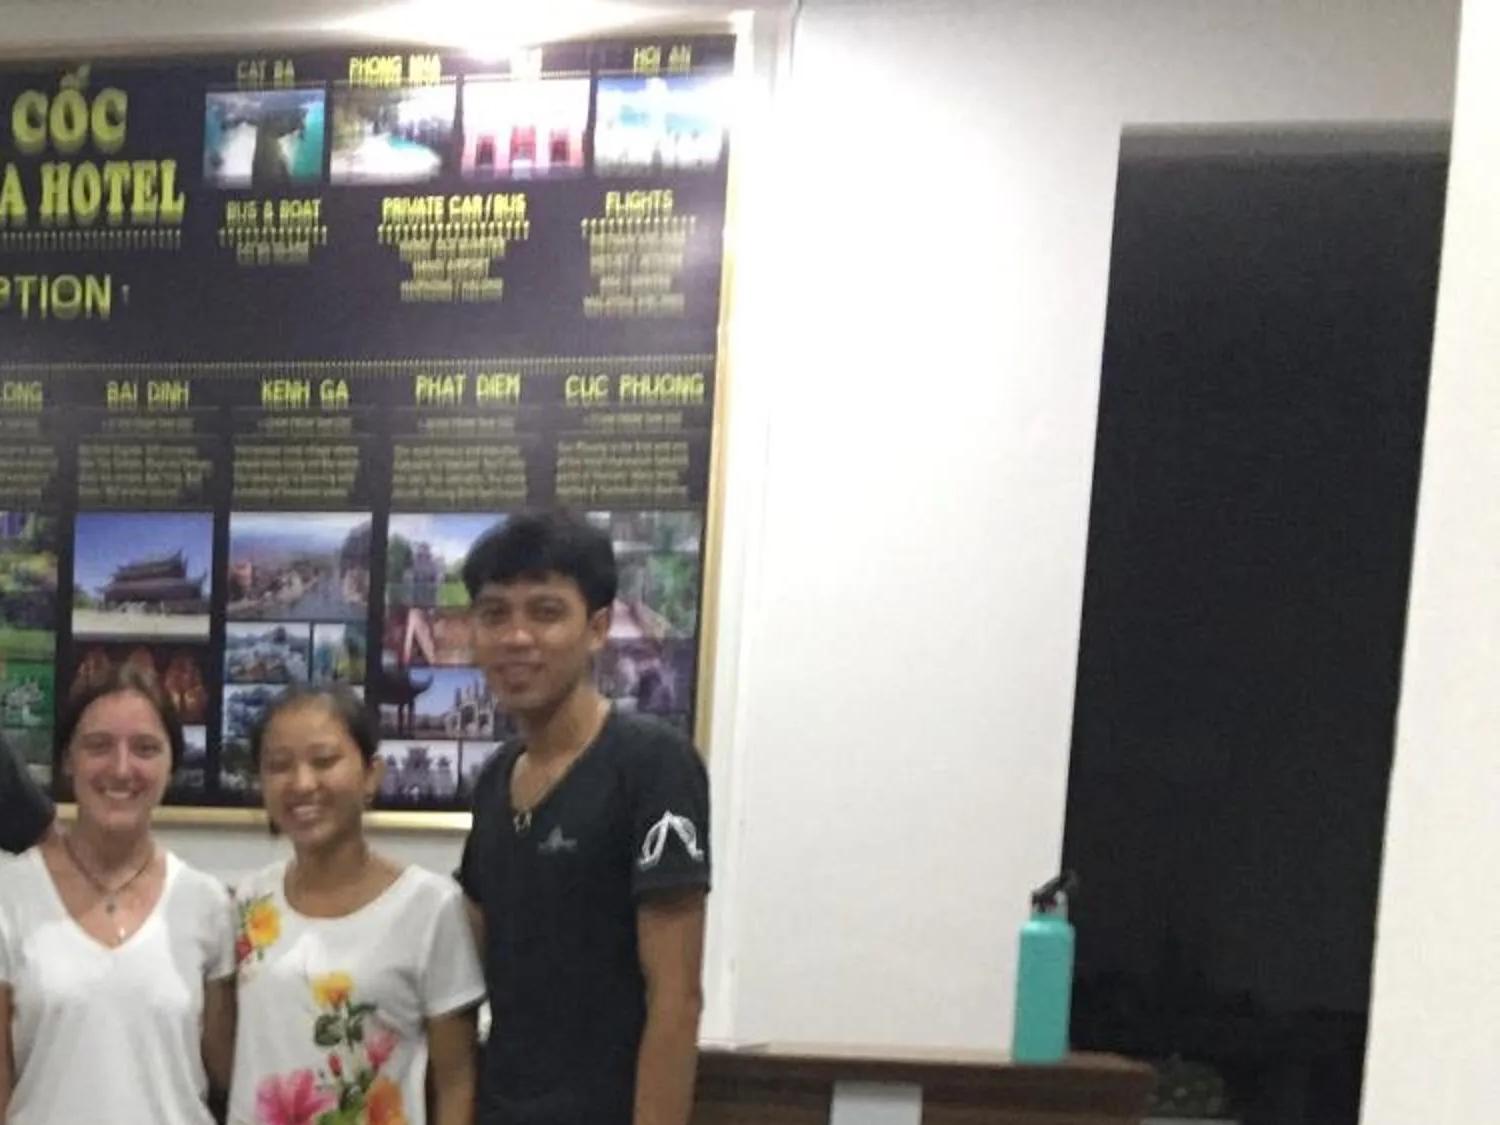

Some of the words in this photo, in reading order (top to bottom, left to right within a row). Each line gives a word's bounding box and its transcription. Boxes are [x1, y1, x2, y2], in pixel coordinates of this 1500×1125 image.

[40, 160, 184, 226] HOTEL
[261, 379, 311, 408] KENH
[320, 378, 349, 408] GA
[416, 375, 467, 404] PHAT
[565, 374, 609, 405] CUC
